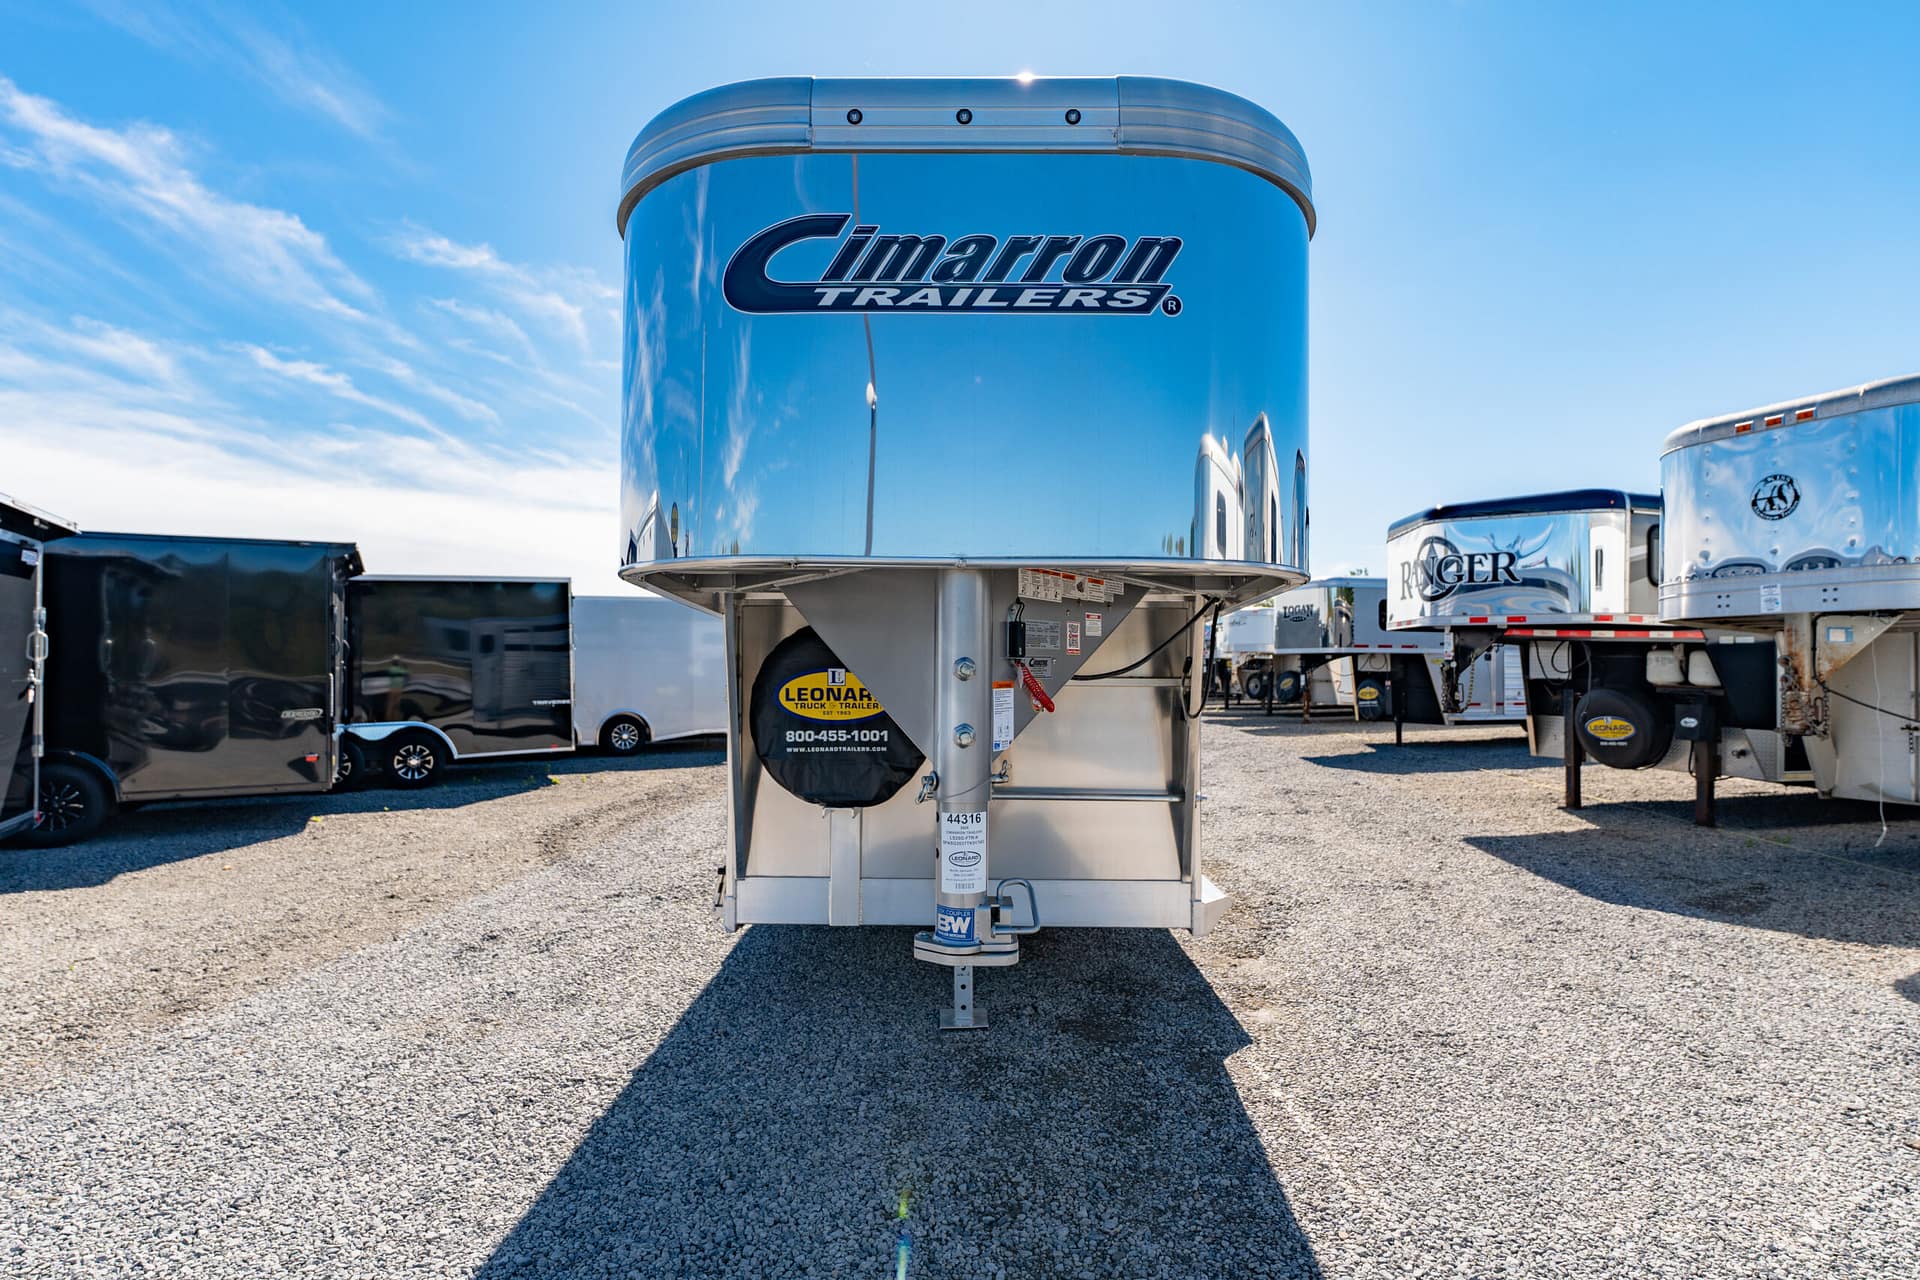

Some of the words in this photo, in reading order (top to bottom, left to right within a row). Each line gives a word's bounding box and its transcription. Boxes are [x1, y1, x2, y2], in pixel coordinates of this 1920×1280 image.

[722, 213, 1184, 314] Cimarron
[813, 286, 1153, 308] TRAILERS
[1400, 551, 1522, 600] RANGER
[1283, 604, 1313, 618] LOGAN
[785, 687, 877, 701] LEONAR
[785, 730, 888, 742] 800-455-1001
[946, 813, 982, 825] 44316
